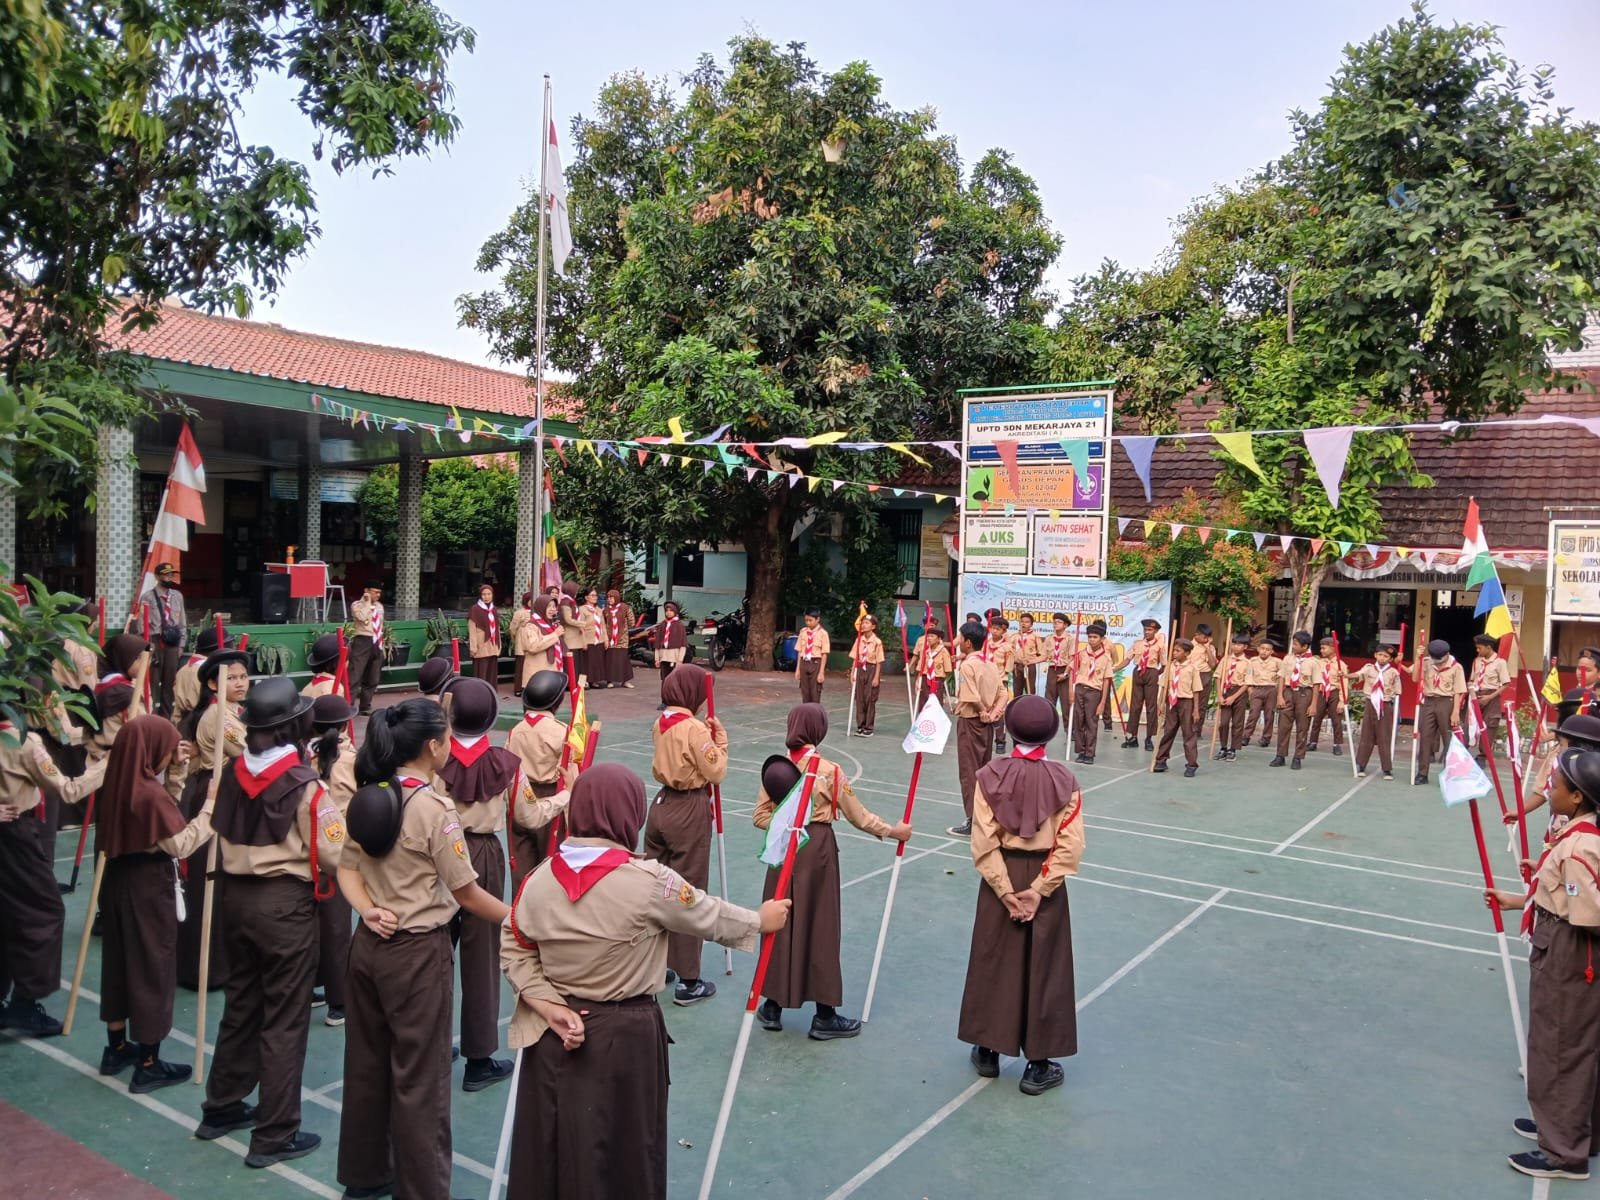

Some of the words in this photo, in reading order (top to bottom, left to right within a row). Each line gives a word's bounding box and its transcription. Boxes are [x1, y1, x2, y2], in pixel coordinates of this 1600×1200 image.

[1024, 422, 1082, 431] MEKARJAYA
[1041, 523, 1068, 533] KANTIN
[1069, 524, 1095, 534] SEHAT
[990, 531, 1014, 543] UKS
[1578, 536, 1595, 552] UPTD
[1413, 572, 1435, 583] TIDAK
[1437, 573, 1468, 584] MEROKO
[1005, 598, 1047, 609] PERSARI
[1048, 600, 1070, 610] DAN
[1071, 602, 1117, 612] PERJUSA
[1109, 615, 1124, 627] 21
